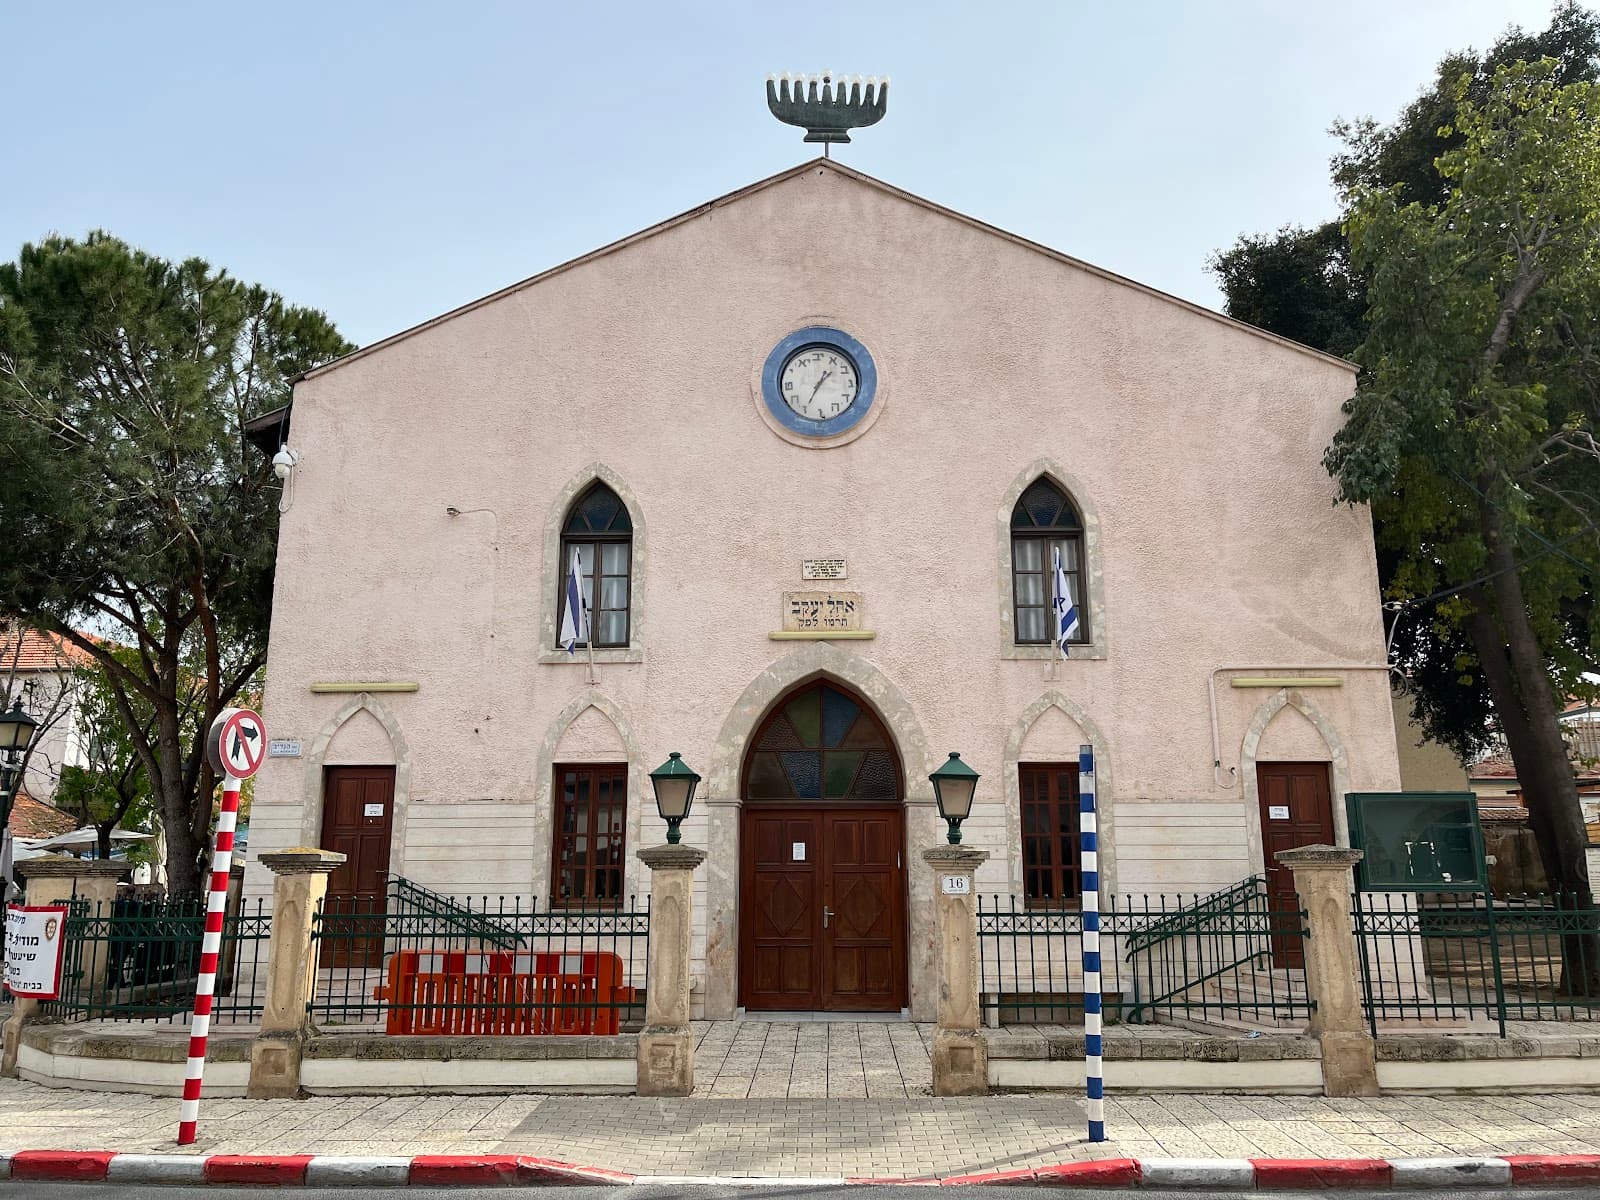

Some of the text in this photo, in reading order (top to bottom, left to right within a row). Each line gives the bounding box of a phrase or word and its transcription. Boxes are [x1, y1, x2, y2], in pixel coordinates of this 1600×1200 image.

[812, 353, 824, 361] יב
[829, 356, 837, 365] א
[798, 359, 810, 367] יא
[841, 366, 849, 374] ב
[848, 380, 853, 388] ג
[842, 394, 850, 402] ד
[831, 403, 839, 412] ה
[792, 596, 854, 616] אהל יעקב
[949, 878, 963, 888] 16
